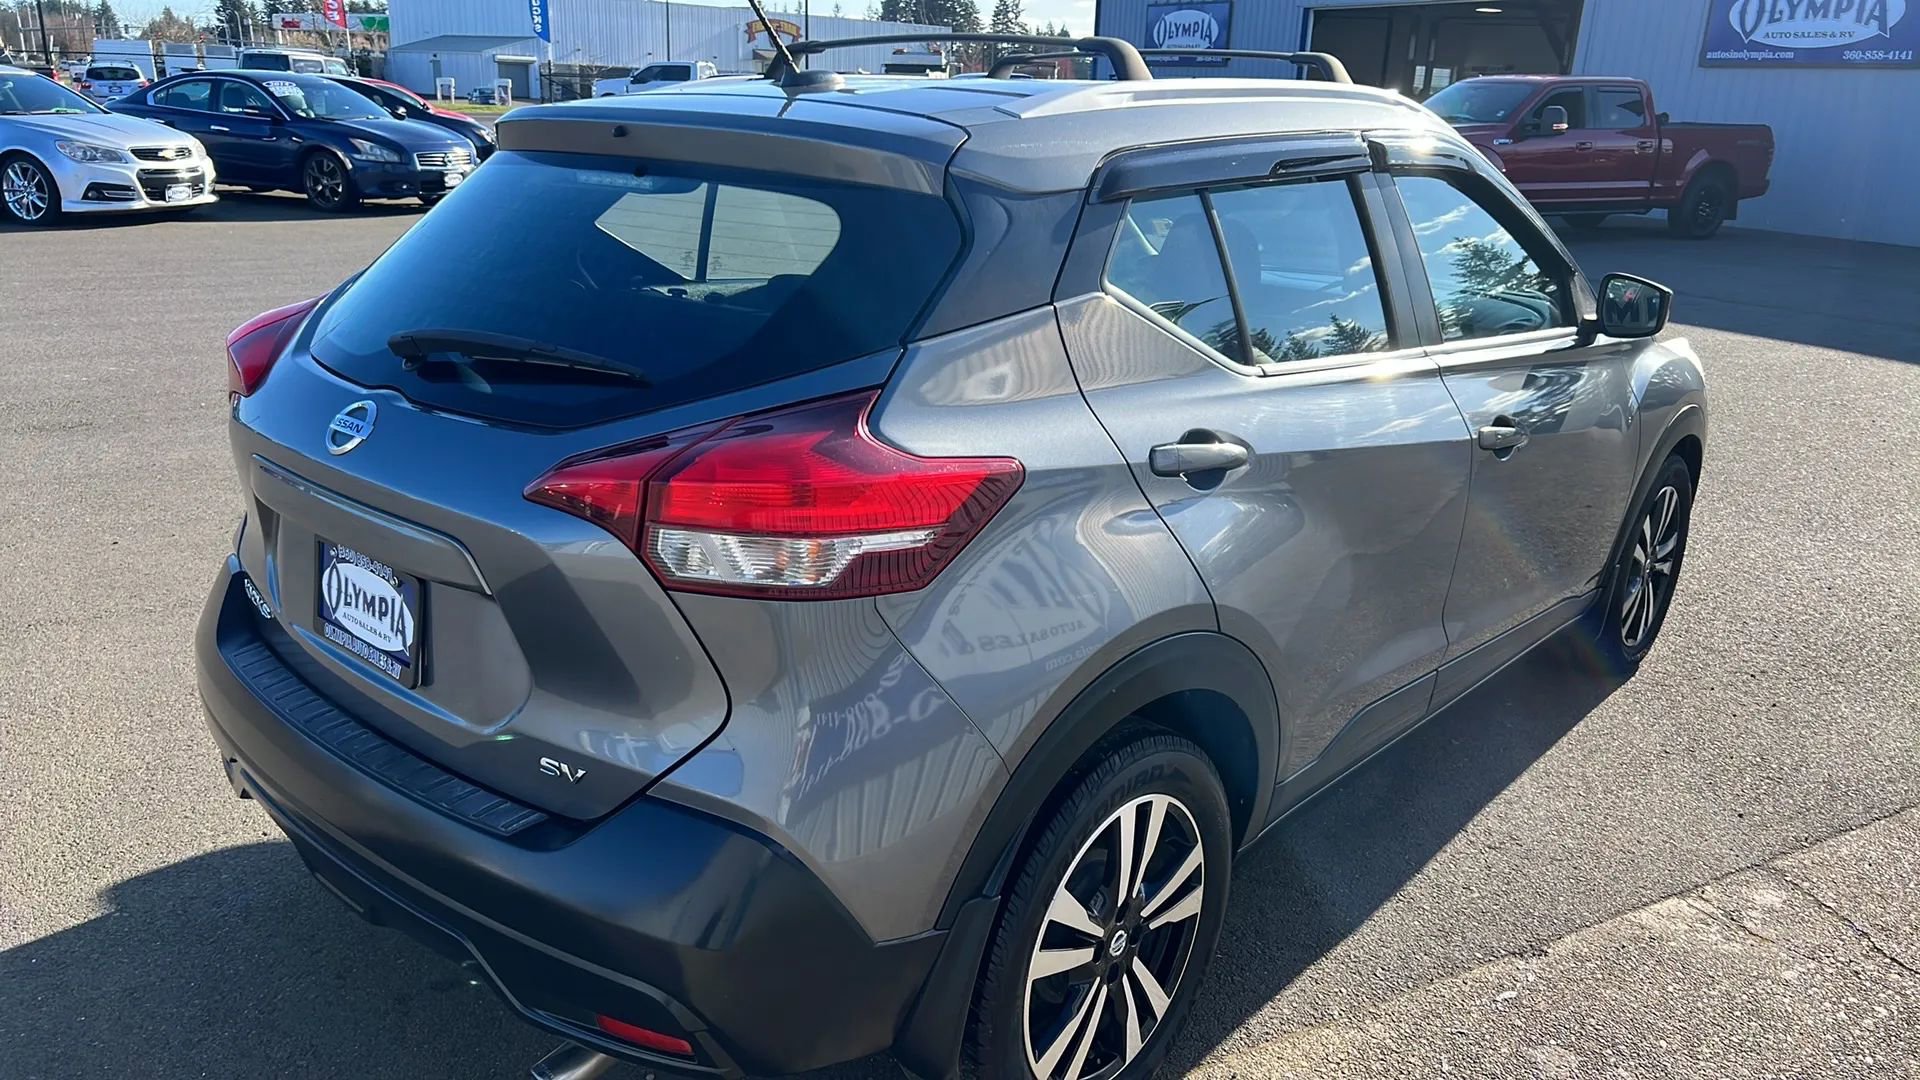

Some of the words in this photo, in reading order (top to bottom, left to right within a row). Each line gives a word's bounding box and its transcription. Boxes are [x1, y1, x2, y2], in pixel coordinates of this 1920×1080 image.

[1157, 16, 1212, 48] OLYMPIA
[1739, 0, 1888, 39] OLYMPIA
[1763, 31, 1792, 39] AUTO
[1793, 31, 1827, 39] SALES
[1829, 31, 1838, 39] &
[1839, 31, 1856, 39] RV
[1706, 49, 1794, 61] autosinolympia.com
[1842, 50, 1913, 60] 360-858-4141
[326, 562, 409, 651] OLYMPIA
[540, 757, 586, 783] SV
